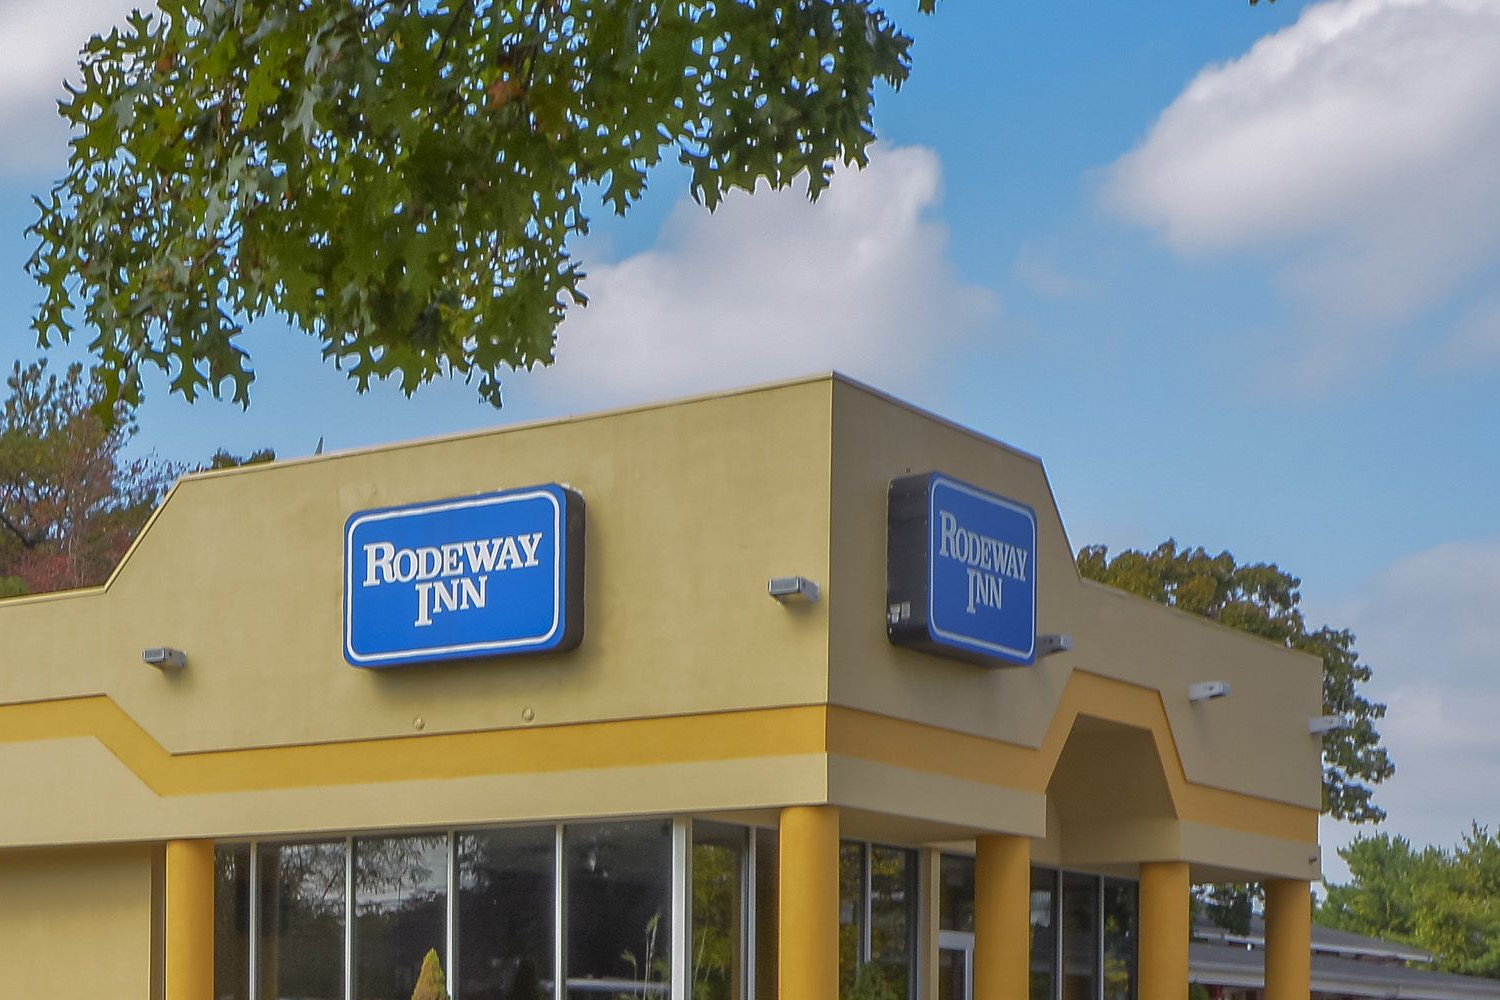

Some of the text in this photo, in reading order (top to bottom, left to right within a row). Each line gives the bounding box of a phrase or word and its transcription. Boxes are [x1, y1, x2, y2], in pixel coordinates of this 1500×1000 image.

[362, 532, 543, 587] RODEWAY
[939, 509, 1028, 582] RODEWAY
[414, 575, 488, 627] INN
[966, 567, 1004, 614] INN
